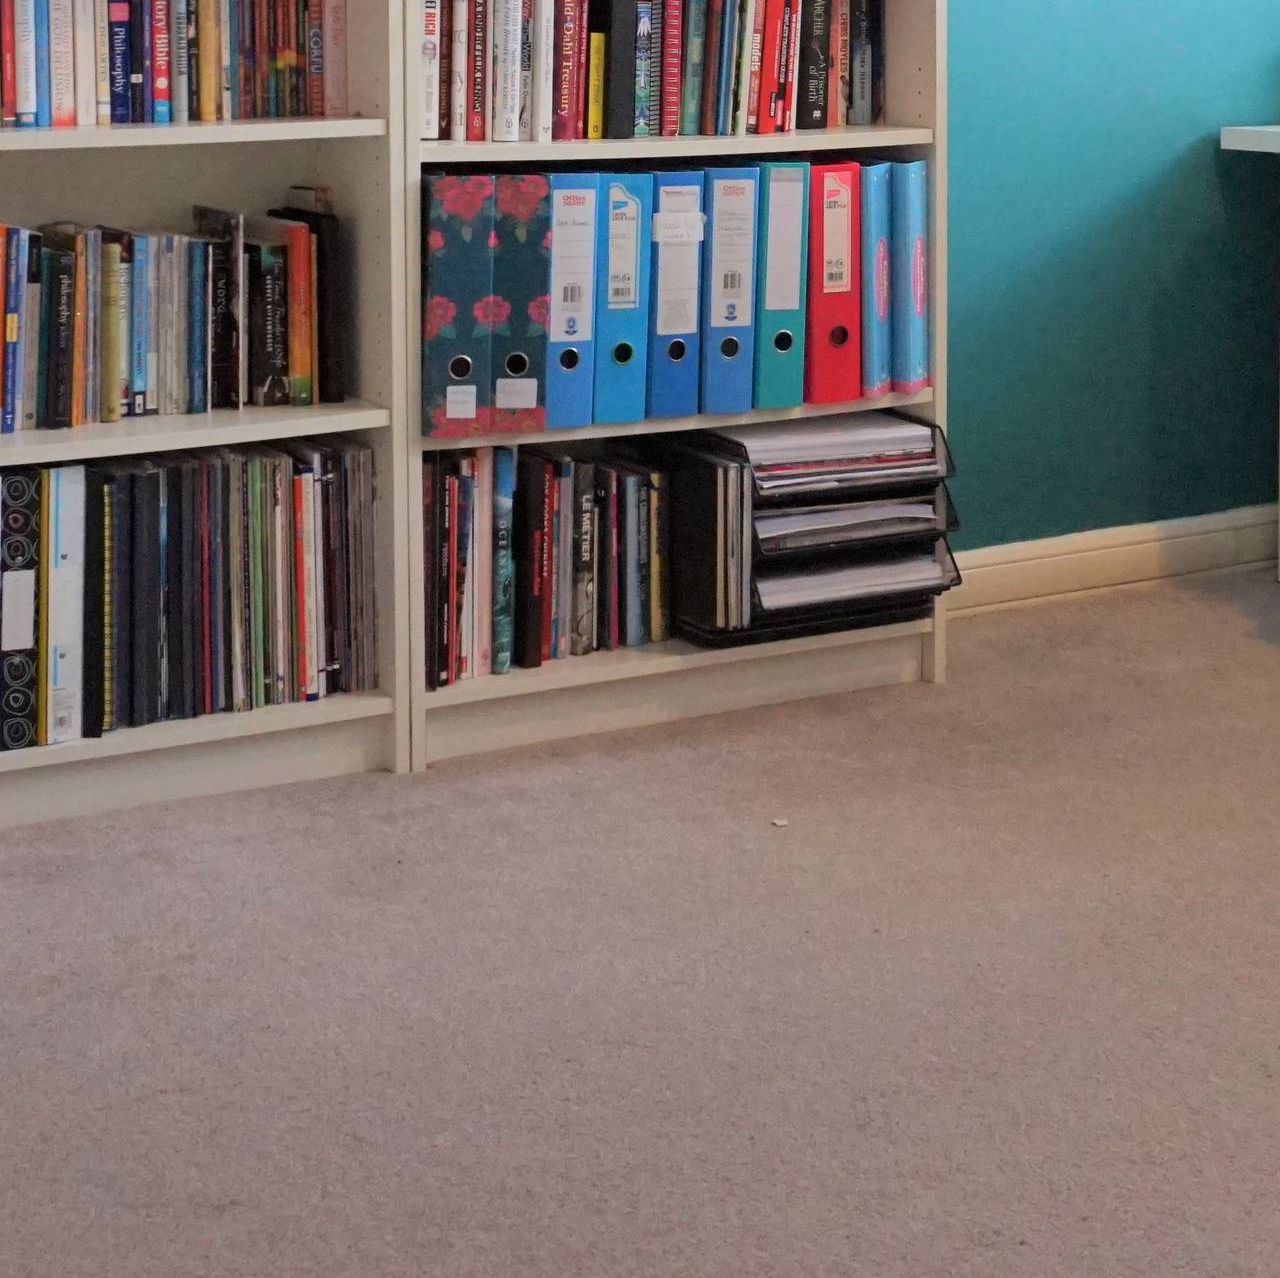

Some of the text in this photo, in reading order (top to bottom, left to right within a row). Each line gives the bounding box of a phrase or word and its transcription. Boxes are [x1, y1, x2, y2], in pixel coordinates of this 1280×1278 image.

[424, 12, 436, 36] RICH
[813, 0, 826, 36] ARCHER
[156, 32, 168, 70] Bible
[563, 23, 574, 55] Dahl
[750, 33, 760, 72] models
[840, 12, 848, 73] CHRIS MOYLES
[110, 27, 125, 93] Philosophy
[558, 58, 572, 117] Treasury
[808, 65, 818, 102] of Birth
[817, 71, 825, 106] Prisoner
[582, 494, 591, 511] LE
